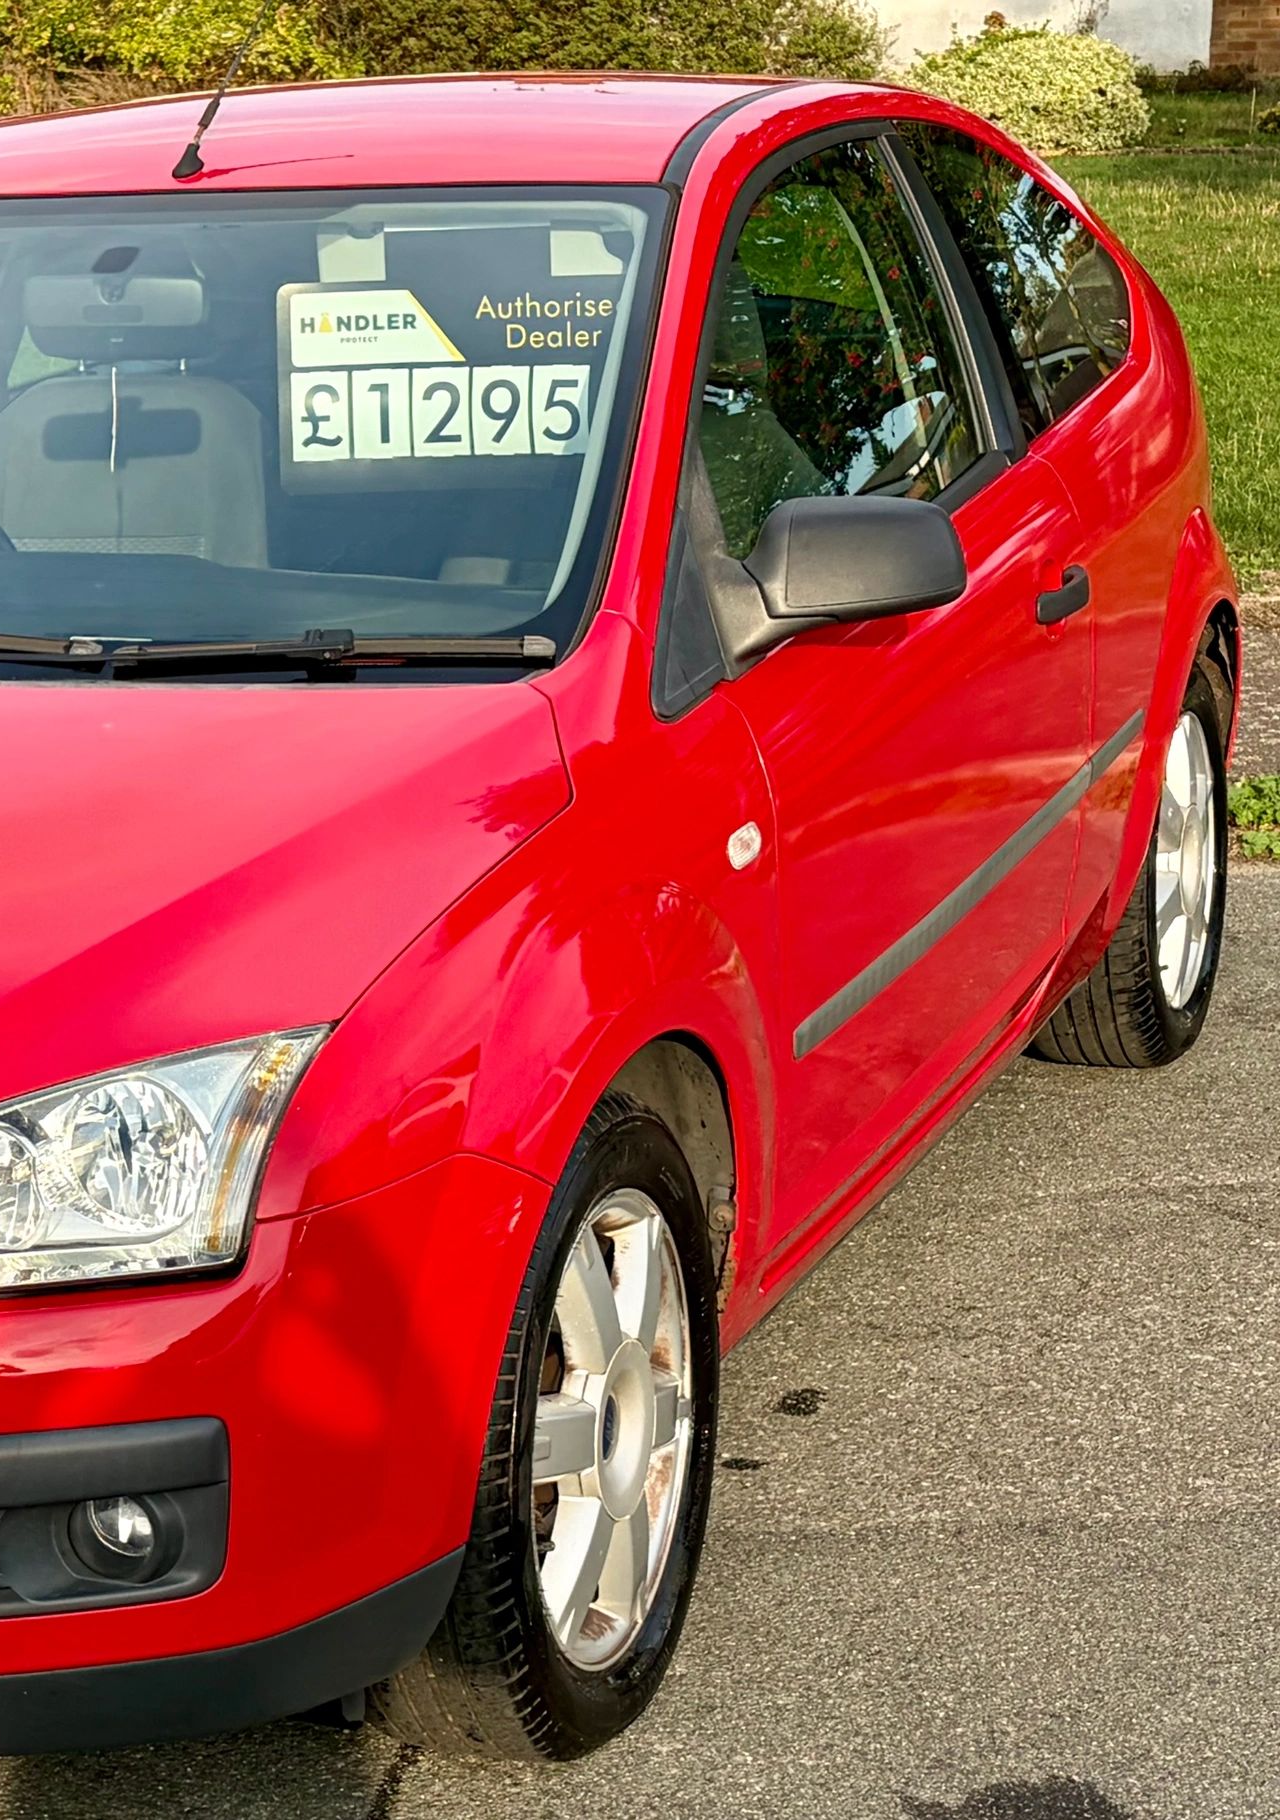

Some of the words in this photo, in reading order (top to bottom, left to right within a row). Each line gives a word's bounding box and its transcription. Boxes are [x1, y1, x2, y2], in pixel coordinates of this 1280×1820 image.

[475, 291, 613, 320] Authorise
[506, 320, 602, 348] Dealer
[300, 379, 581, 448] £1295
